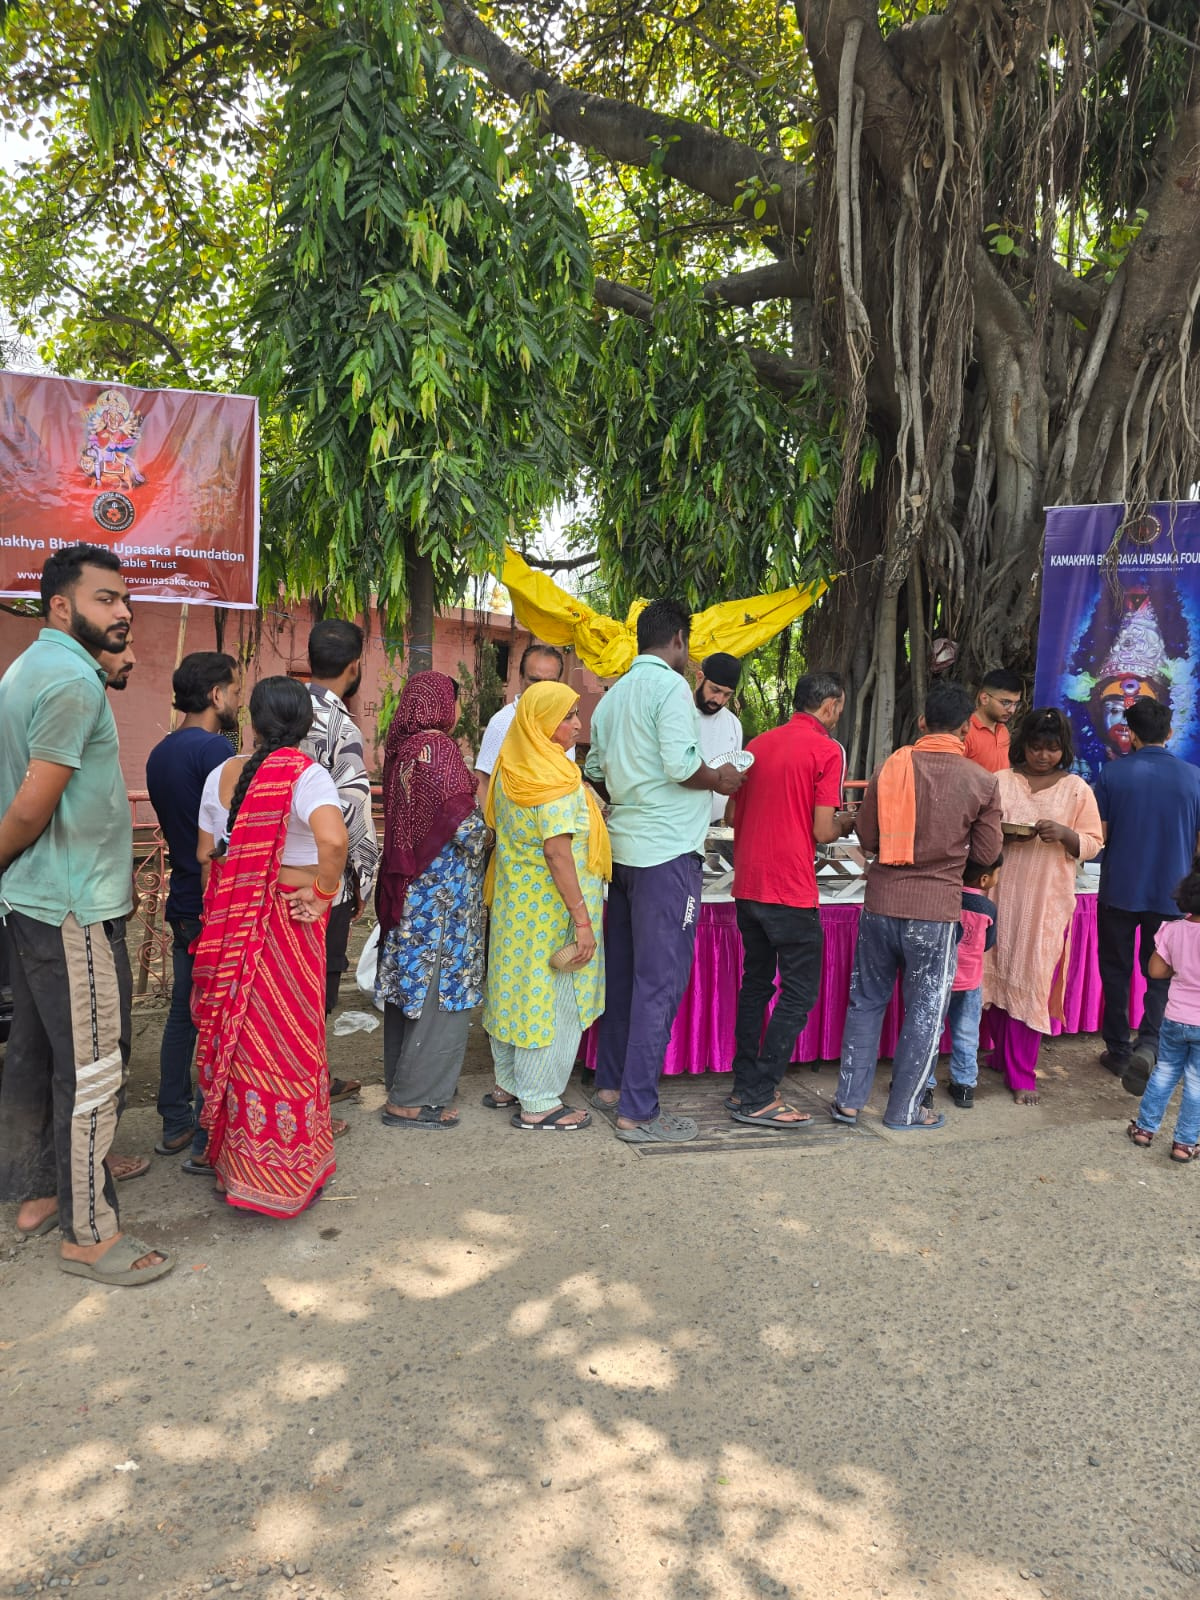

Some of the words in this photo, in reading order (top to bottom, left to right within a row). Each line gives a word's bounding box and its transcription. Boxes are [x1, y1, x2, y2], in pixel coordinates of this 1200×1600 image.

[113, 542, 171, 557] Upasaka
[175, 546, 245, 562] Foundation
[1050, 554, 1096, 566] KAMAKHYA
[1140, 552, 1179, 565] UPASAKA
[150, 559, 177, 570] Trust
